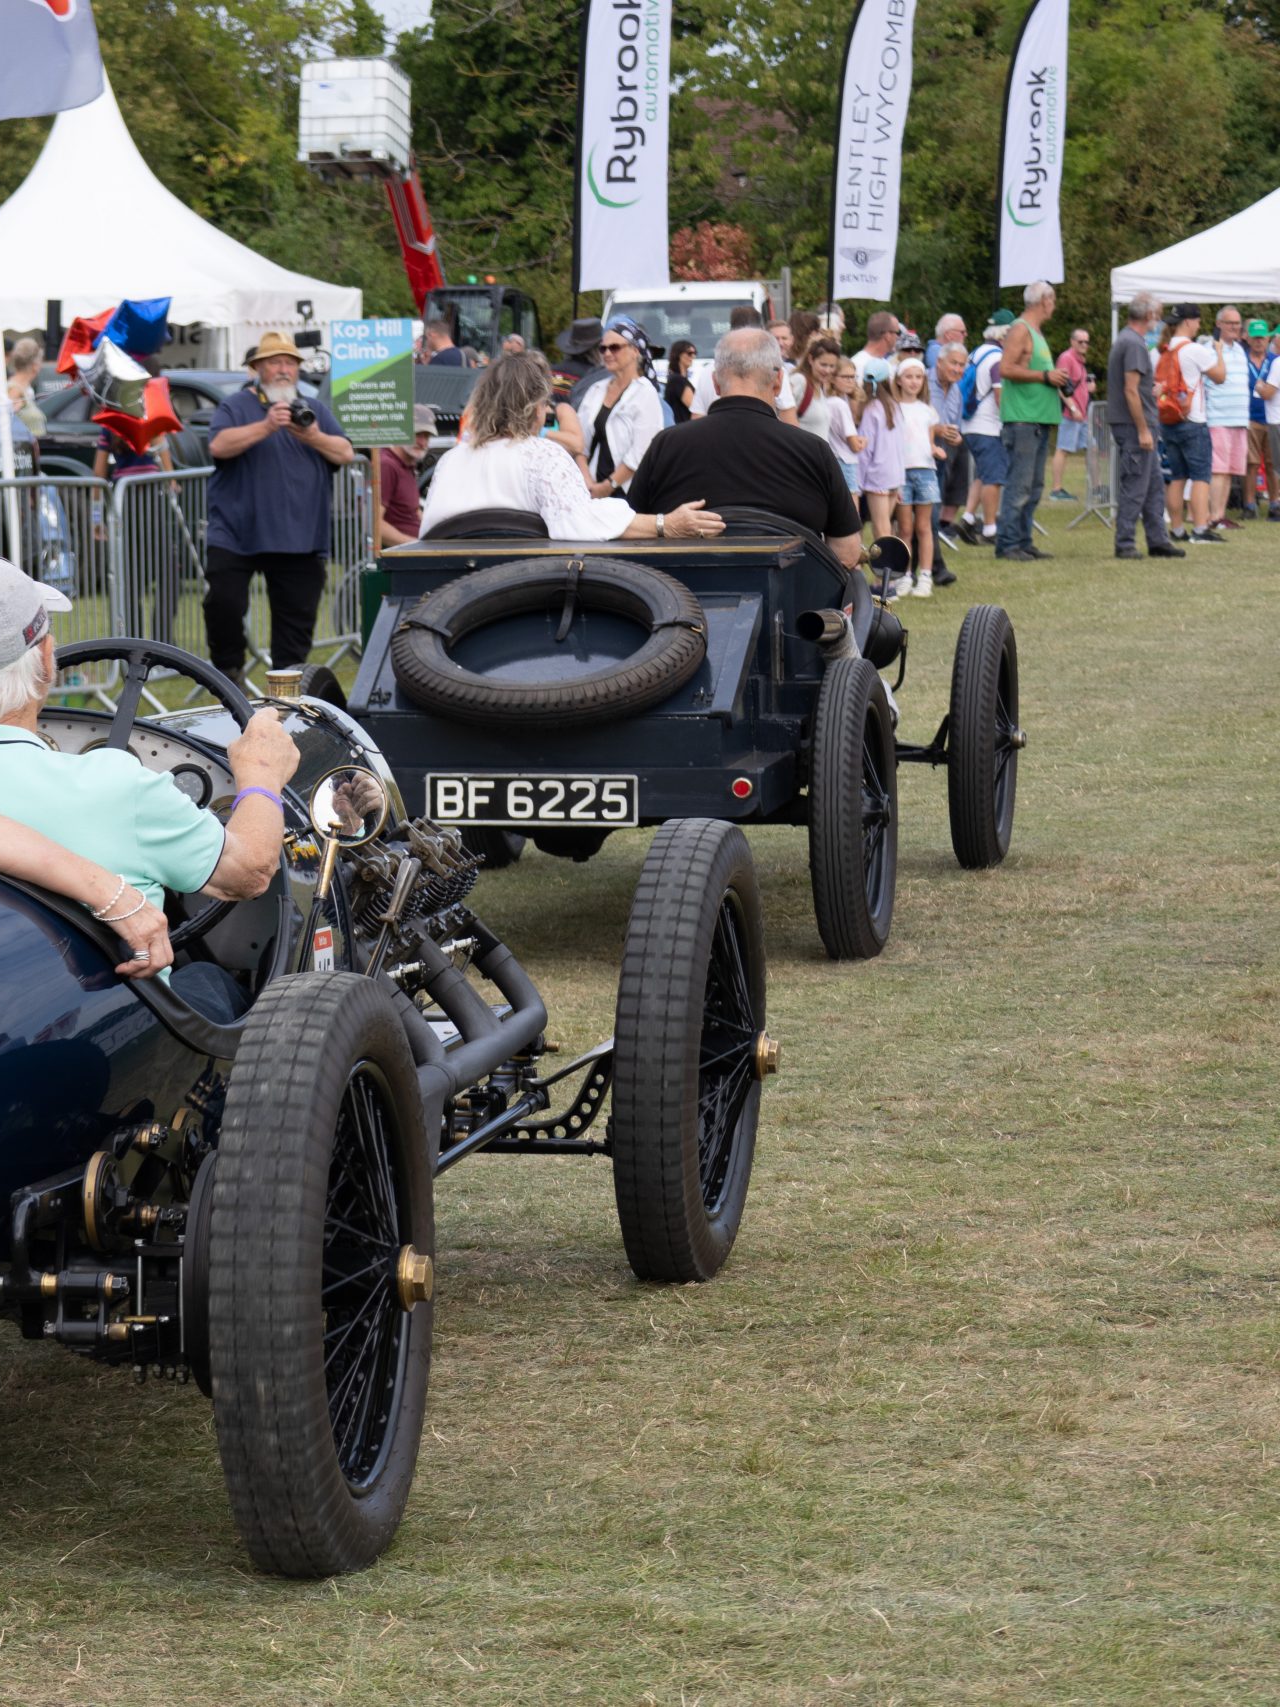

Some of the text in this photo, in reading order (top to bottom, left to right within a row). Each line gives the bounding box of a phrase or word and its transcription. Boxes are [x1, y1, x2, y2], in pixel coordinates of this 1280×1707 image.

[867, 0, 906, 232] HIGH WYCOMB
[1046, 65, 1058, 165] automotive
[842, 83, 871, 230] BENTLEY
[332, 319, 402, 341] Kop Hill
[333, 342, 389, 360] Climb
[349, 379, 396, 390] Drivers and
[338, 401, 407, 412] undertake the hill
[348, 392, 397, 402] passengers
[341, 412, 405, 422] at their own risk
[436, 779, 628, 820] BF 6225
